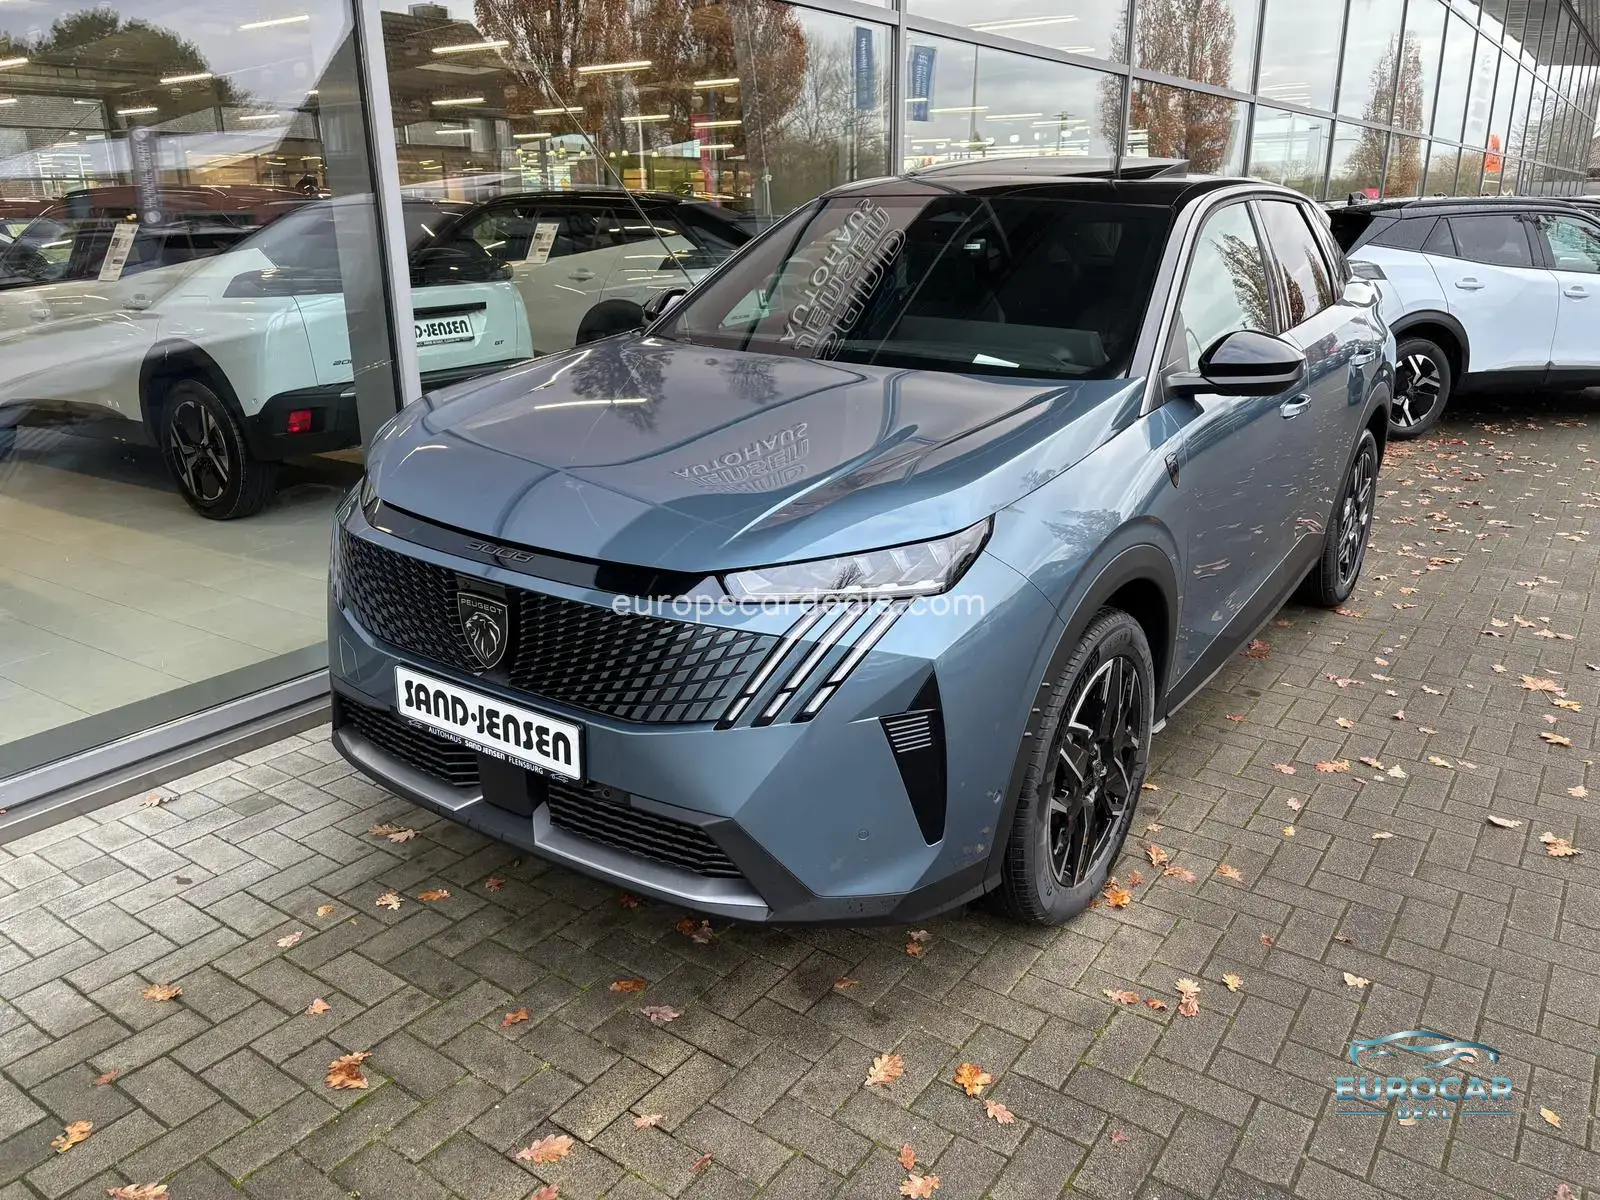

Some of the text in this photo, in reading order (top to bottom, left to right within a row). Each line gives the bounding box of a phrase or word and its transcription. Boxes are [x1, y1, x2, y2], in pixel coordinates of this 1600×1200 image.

[465, 541, 534, 563] 3008
[460, 598, 503, 615] PEUGEOT
[428, 726, 544, 775] AUTOHAUS SAND JENSEN FLENSBURG
